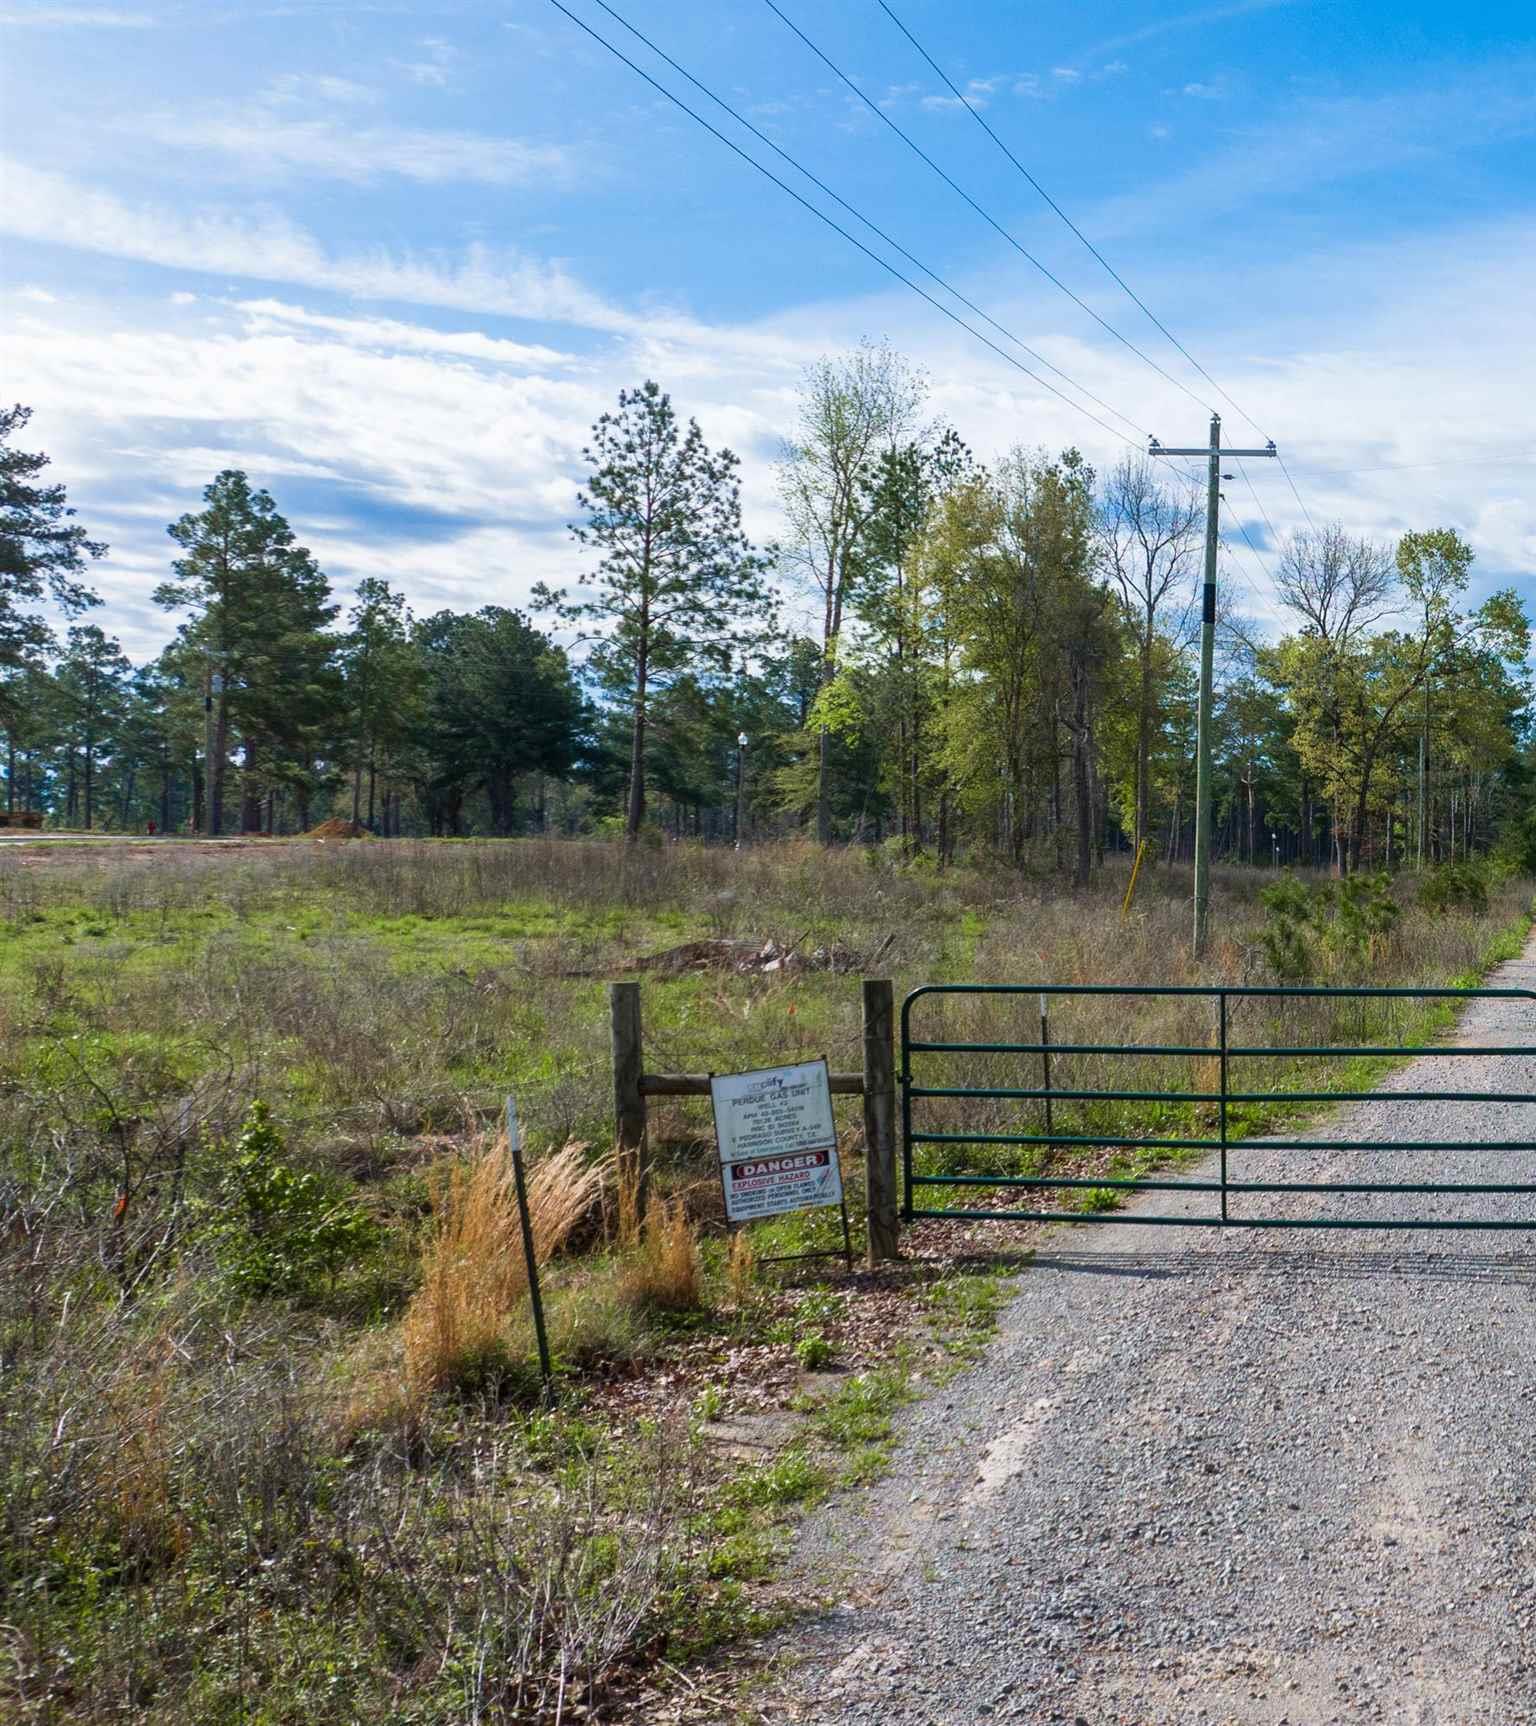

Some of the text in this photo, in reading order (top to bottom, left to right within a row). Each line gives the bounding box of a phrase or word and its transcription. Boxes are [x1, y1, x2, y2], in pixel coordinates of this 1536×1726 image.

[731, 1095, 766, 1106] PERDUE
[769, 1091, 789, 1099] GAS
[744, 1156, 817, 1175] DANGER
[732, 1172, 810, 1188] EXPLOSIVE HAZARD
